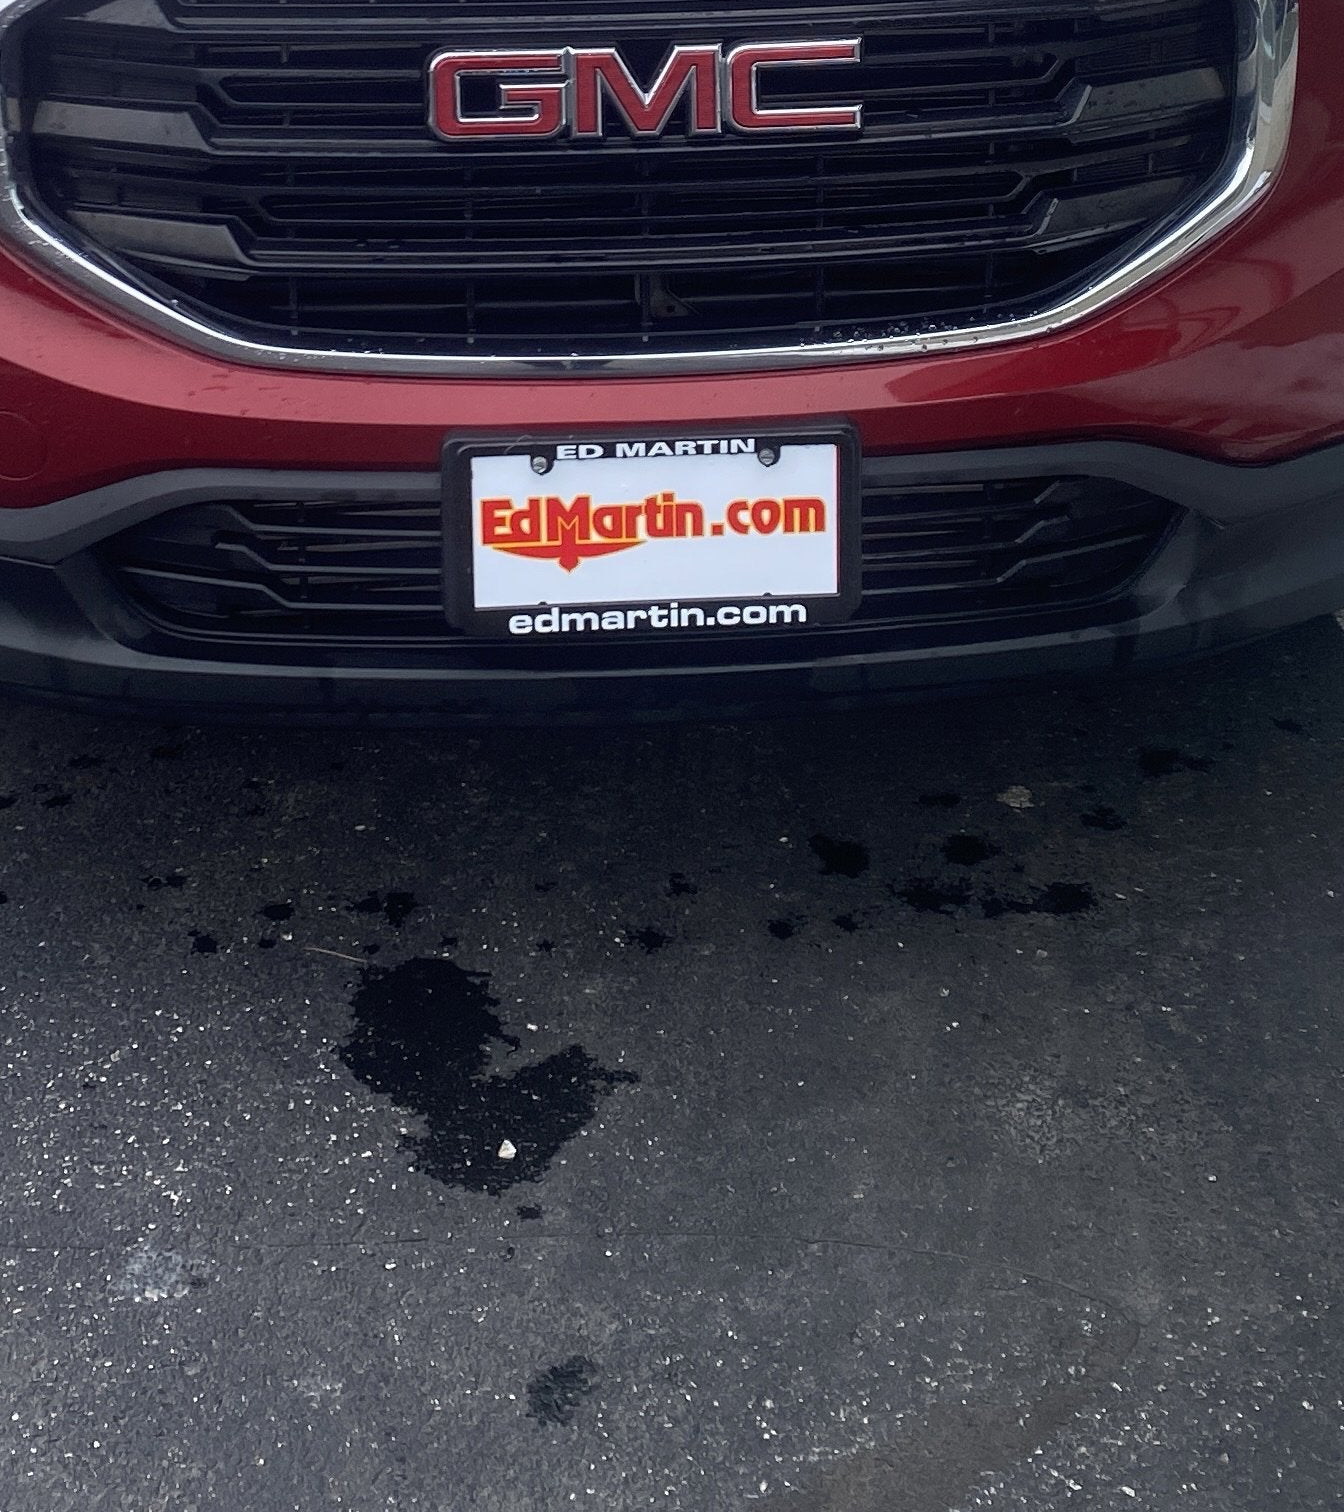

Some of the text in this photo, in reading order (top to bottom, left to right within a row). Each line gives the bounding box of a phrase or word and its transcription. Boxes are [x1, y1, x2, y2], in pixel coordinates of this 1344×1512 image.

[426, 36, 864, 143] GMC
[555, 438, 757, 461] ED MARTIN
[479, 491, 827, 546] EdMartin.com
[507, 601, 808, 636] edmartin.com
